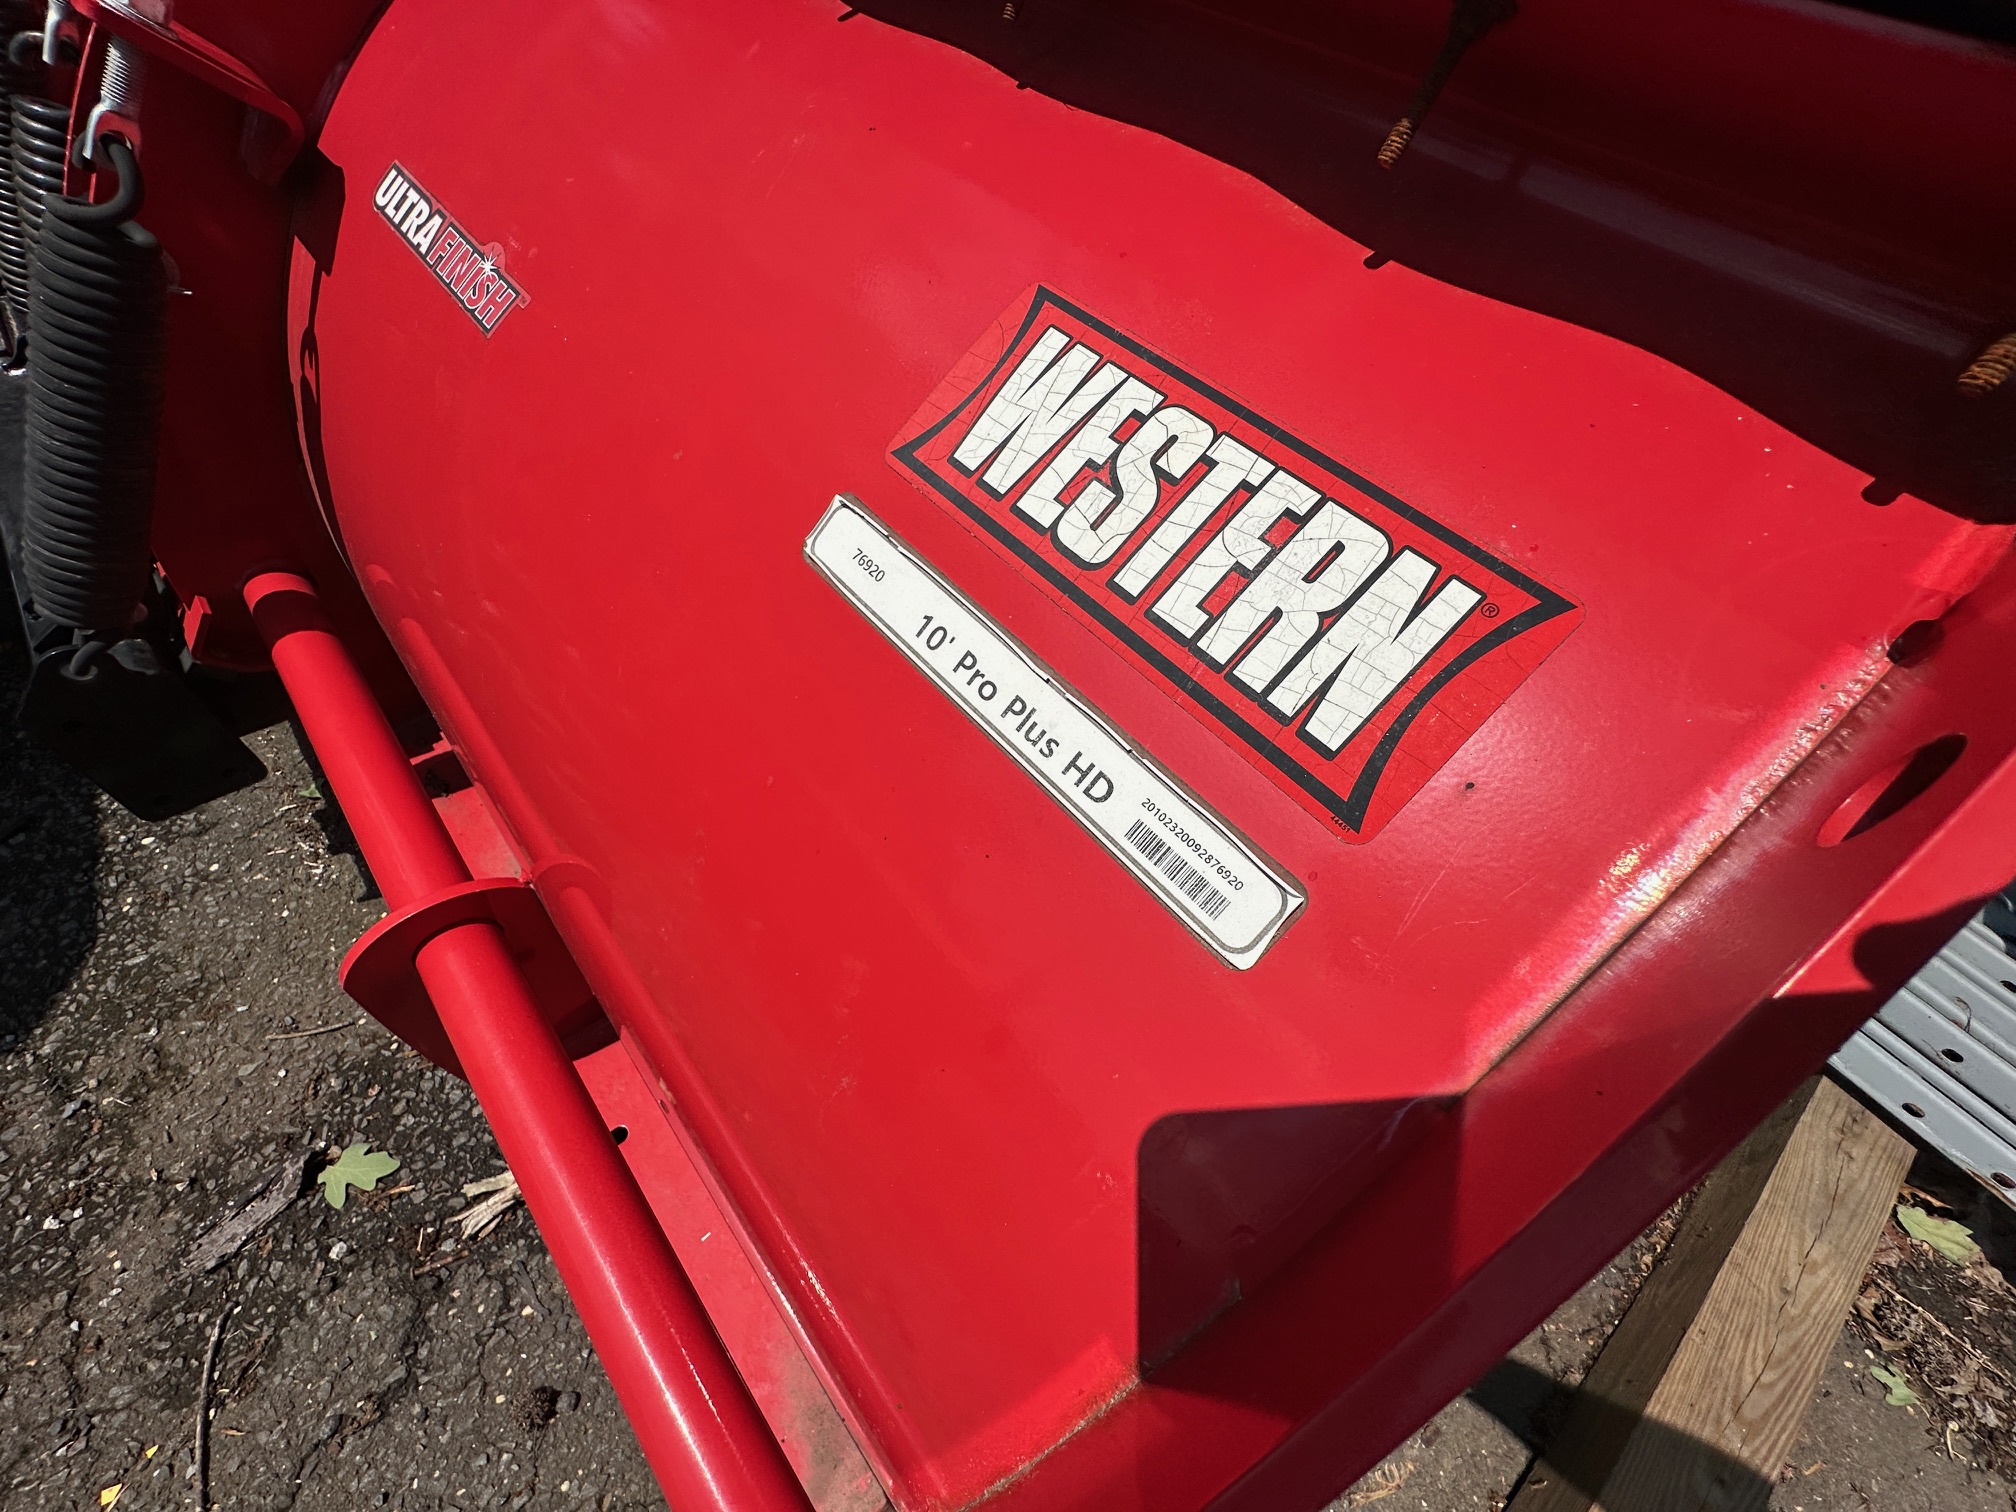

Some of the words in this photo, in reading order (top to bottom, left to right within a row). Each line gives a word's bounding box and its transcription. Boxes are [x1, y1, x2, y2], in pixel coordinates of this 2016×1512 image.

[375, 168, 443, 254] ULTRA
[426, 227, 516, 329] FINISH
[852, 548, 886, 582] 76920
[950, 324, 1485, 756] WESTERN
[915, 615, 956, 651] 10'
[952, 650, 998, 701] Pro
[1000, 694, 1060, 758] Plus
[1061, 750, 1115, 803] HD
[1141, 797, 1244, 891] 20102320092876920
[1330, 815, 1351, 834] 44451
